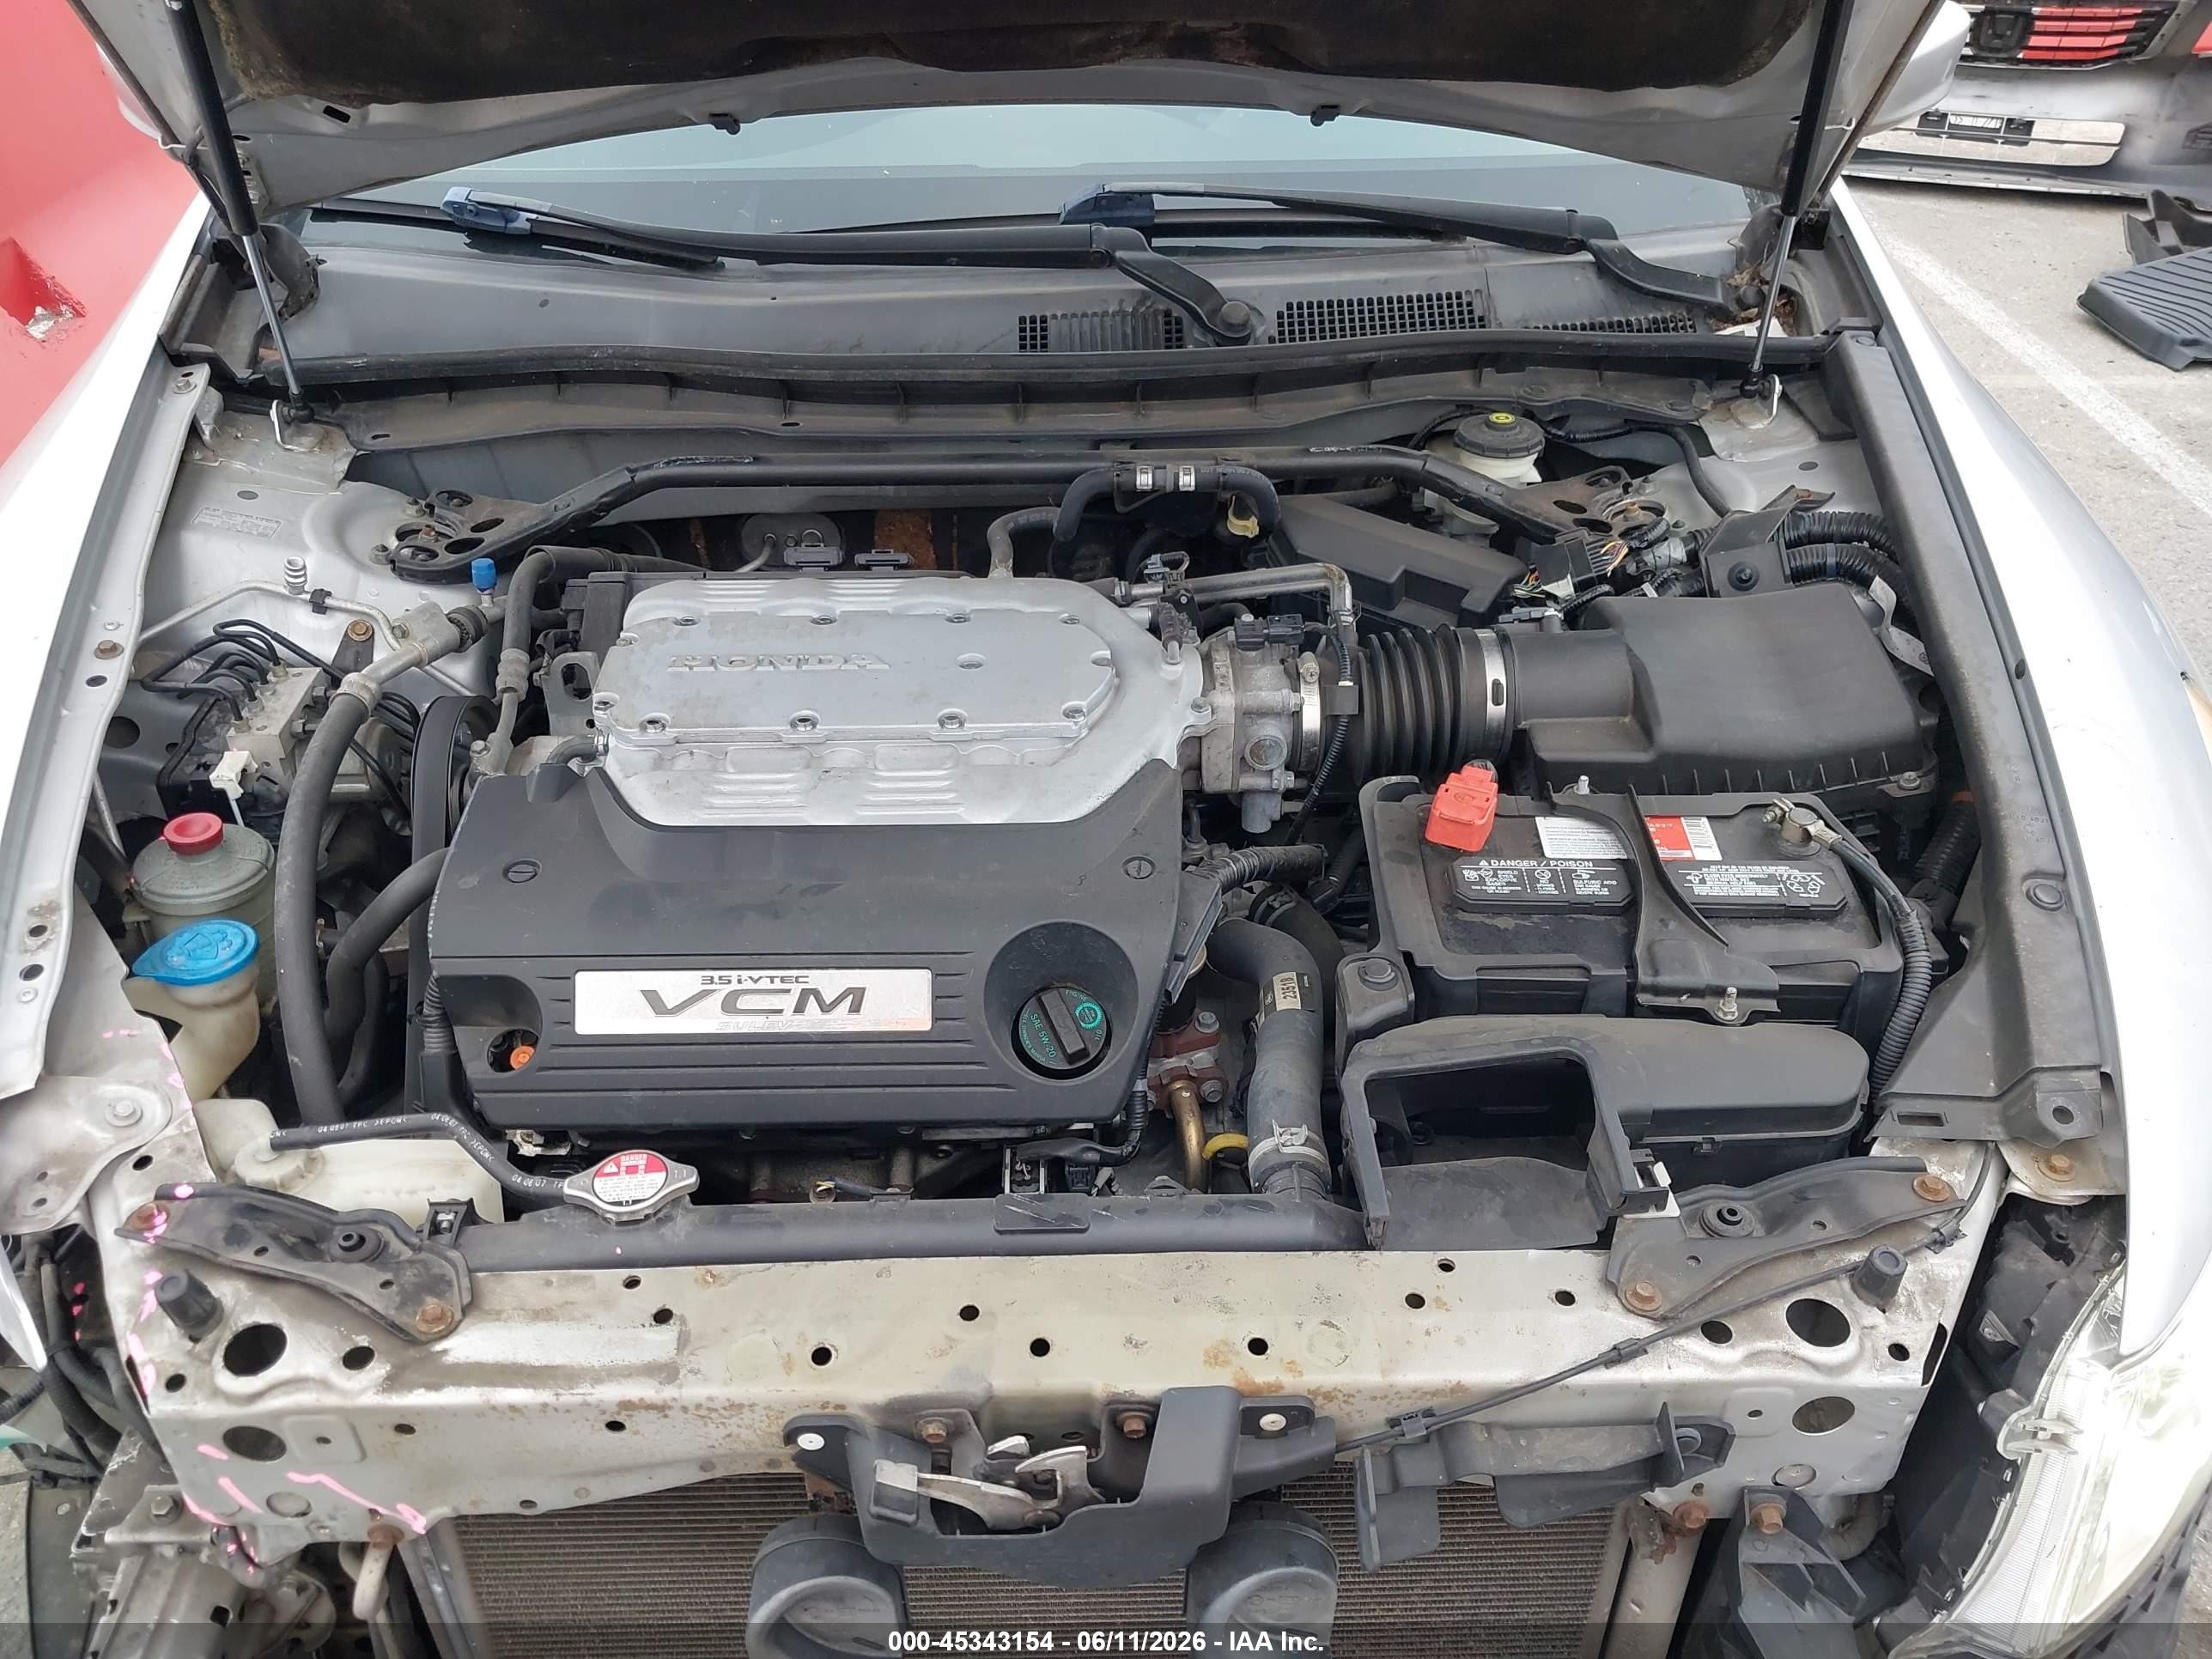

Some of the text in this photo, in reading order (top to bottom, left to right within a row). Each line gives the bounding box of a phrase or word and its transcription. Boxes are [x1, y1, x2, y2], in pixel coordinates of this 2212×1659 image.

[666, 653, 891, 672] HONDA
[700, 975, 810, 985] 3.5 i-VTEC
[638, 986, 868, 1017] VCM
[1065, 989, 1089, 1002] ENGINE
[715, 1020, 793, 1031] SULEV
[1030, 1013, 1057, 1059] SAE 5W-20
